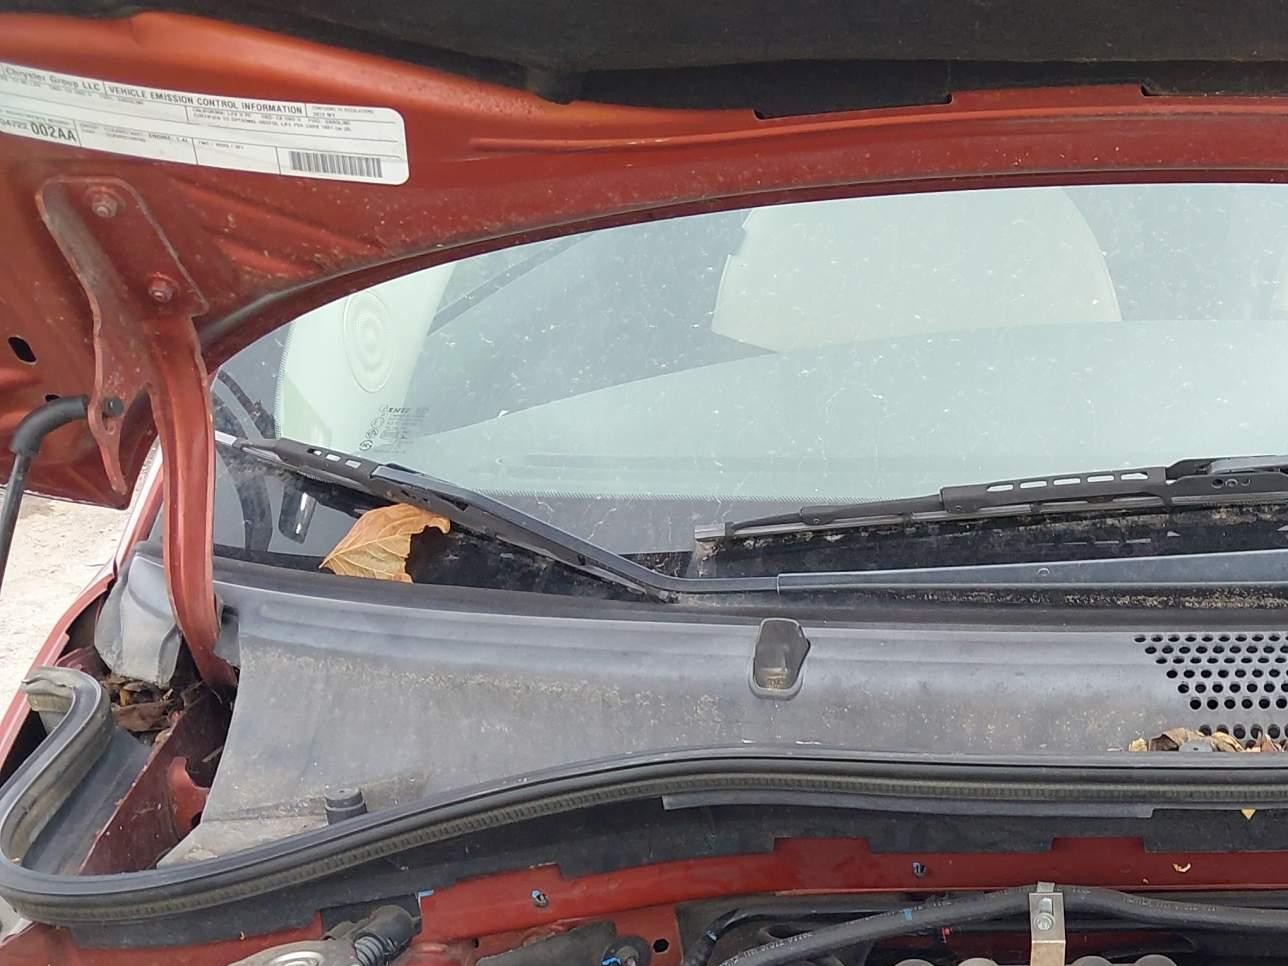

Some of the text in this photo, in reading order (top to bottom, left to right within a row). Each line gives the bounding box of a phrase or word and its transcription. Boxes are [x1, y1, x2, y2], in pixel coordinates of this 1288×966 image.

[6, 67, 46, 80] Chrysler
[49, 75, 79, 89] Group
[81, 81, 101, 92] LLC
[108, 87, 145, 99] VEHICLE
[150, 93, 194, 105] EMISSION
[197, 98, 238, 110] CONTROL
[241, 101, 303, 114] INFORMATION
[31, 121, 78, 142] 002AA
